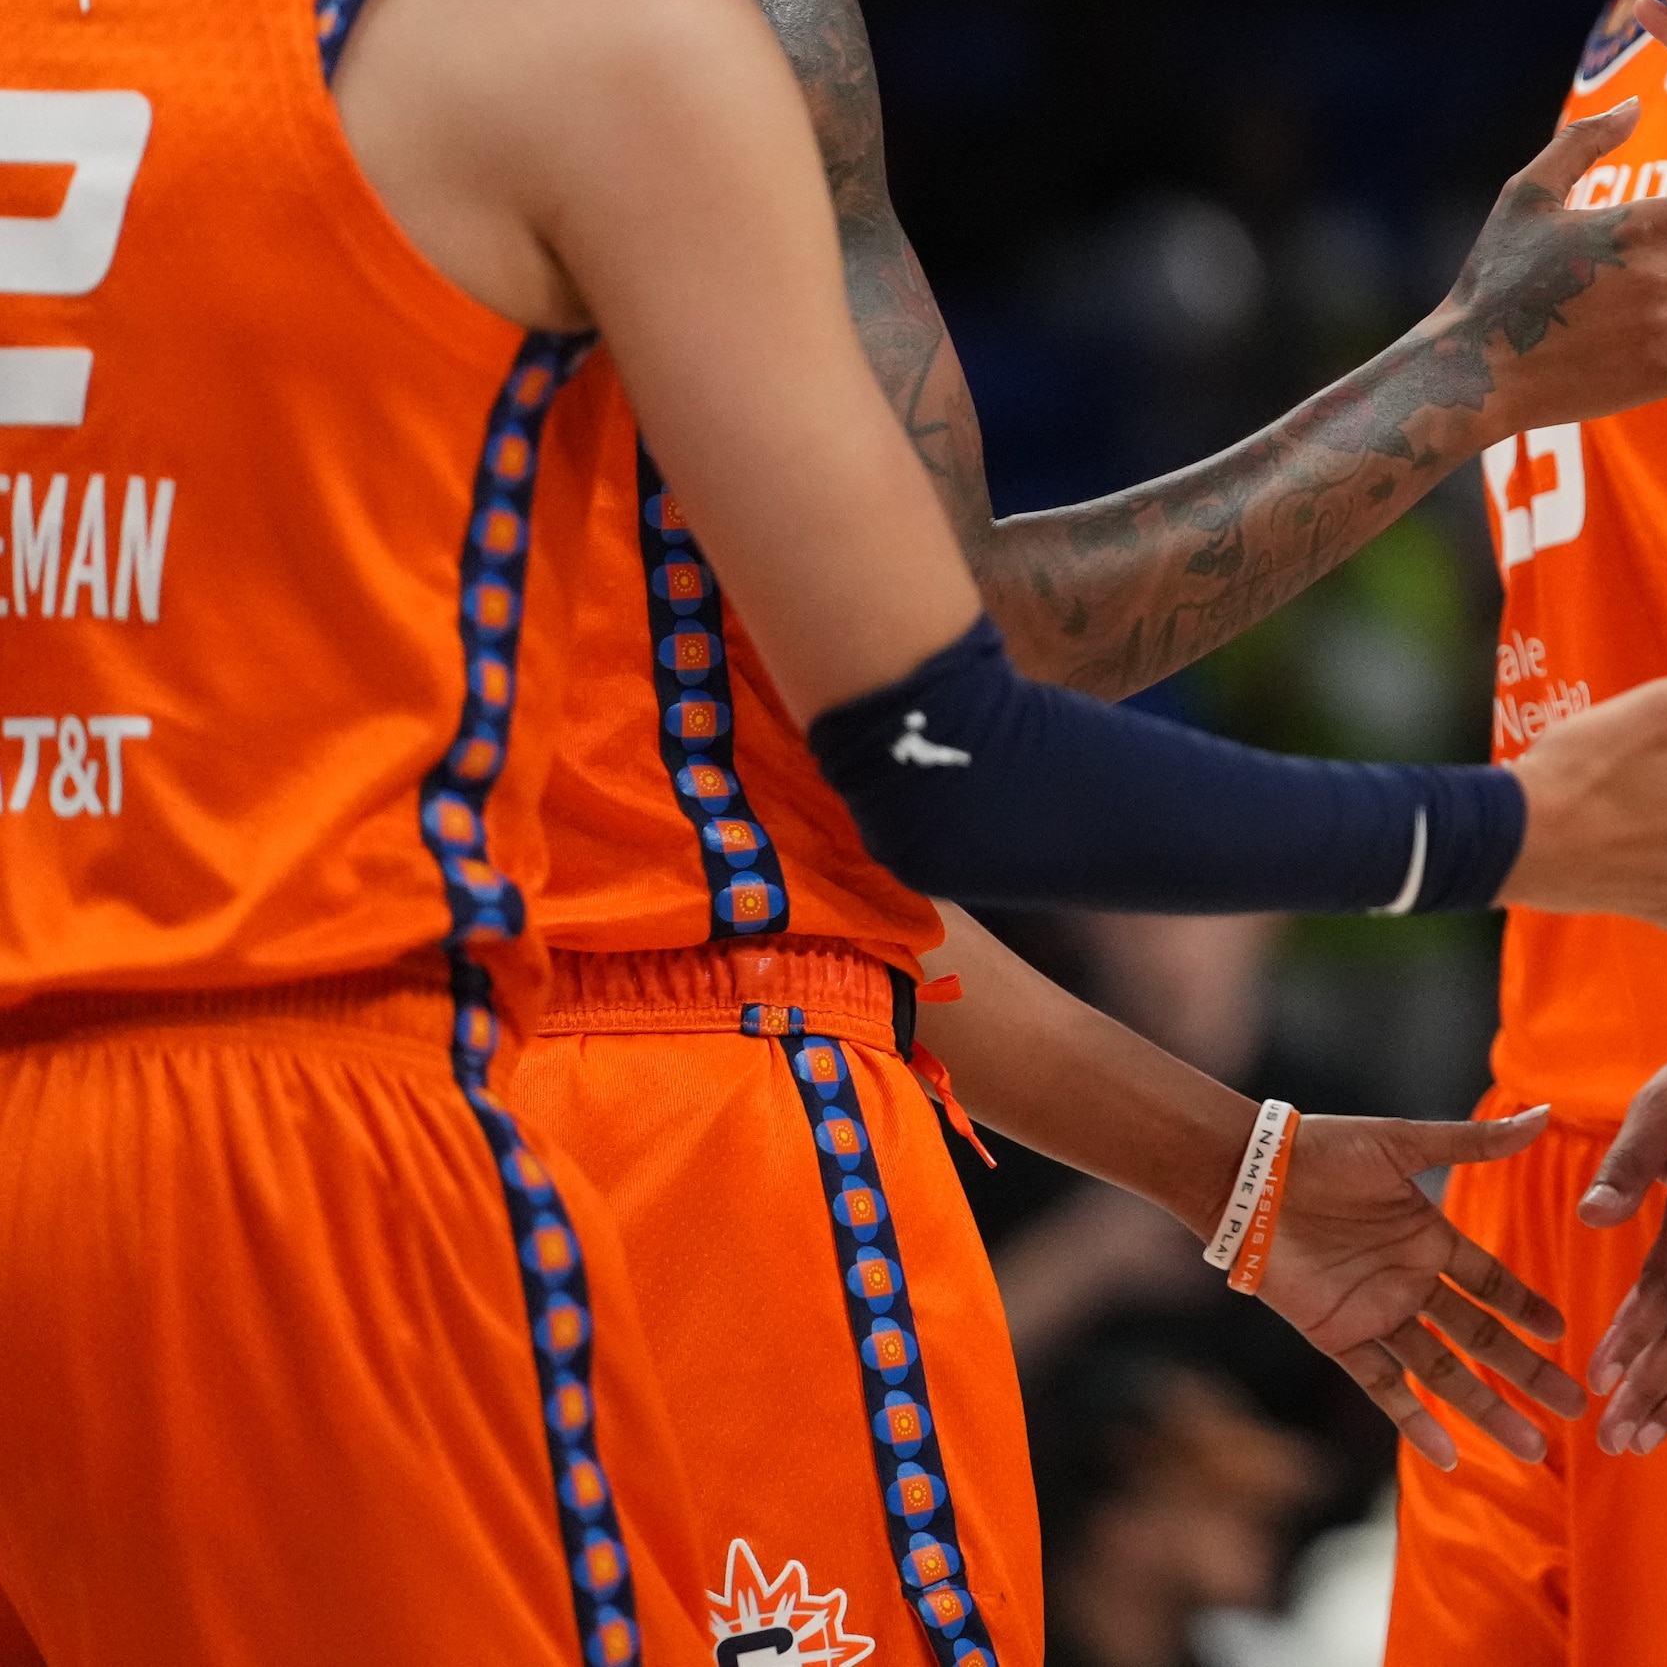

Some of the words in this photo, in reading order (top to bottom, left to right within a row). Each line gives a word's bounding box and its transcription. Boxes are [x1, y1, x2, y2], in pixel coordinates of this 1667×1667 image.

[0, 714, 152, 818] T&T
[1241, 1129, 1274, 1195] NAME
[1214, 1218, 1243, 1264] PLAY
